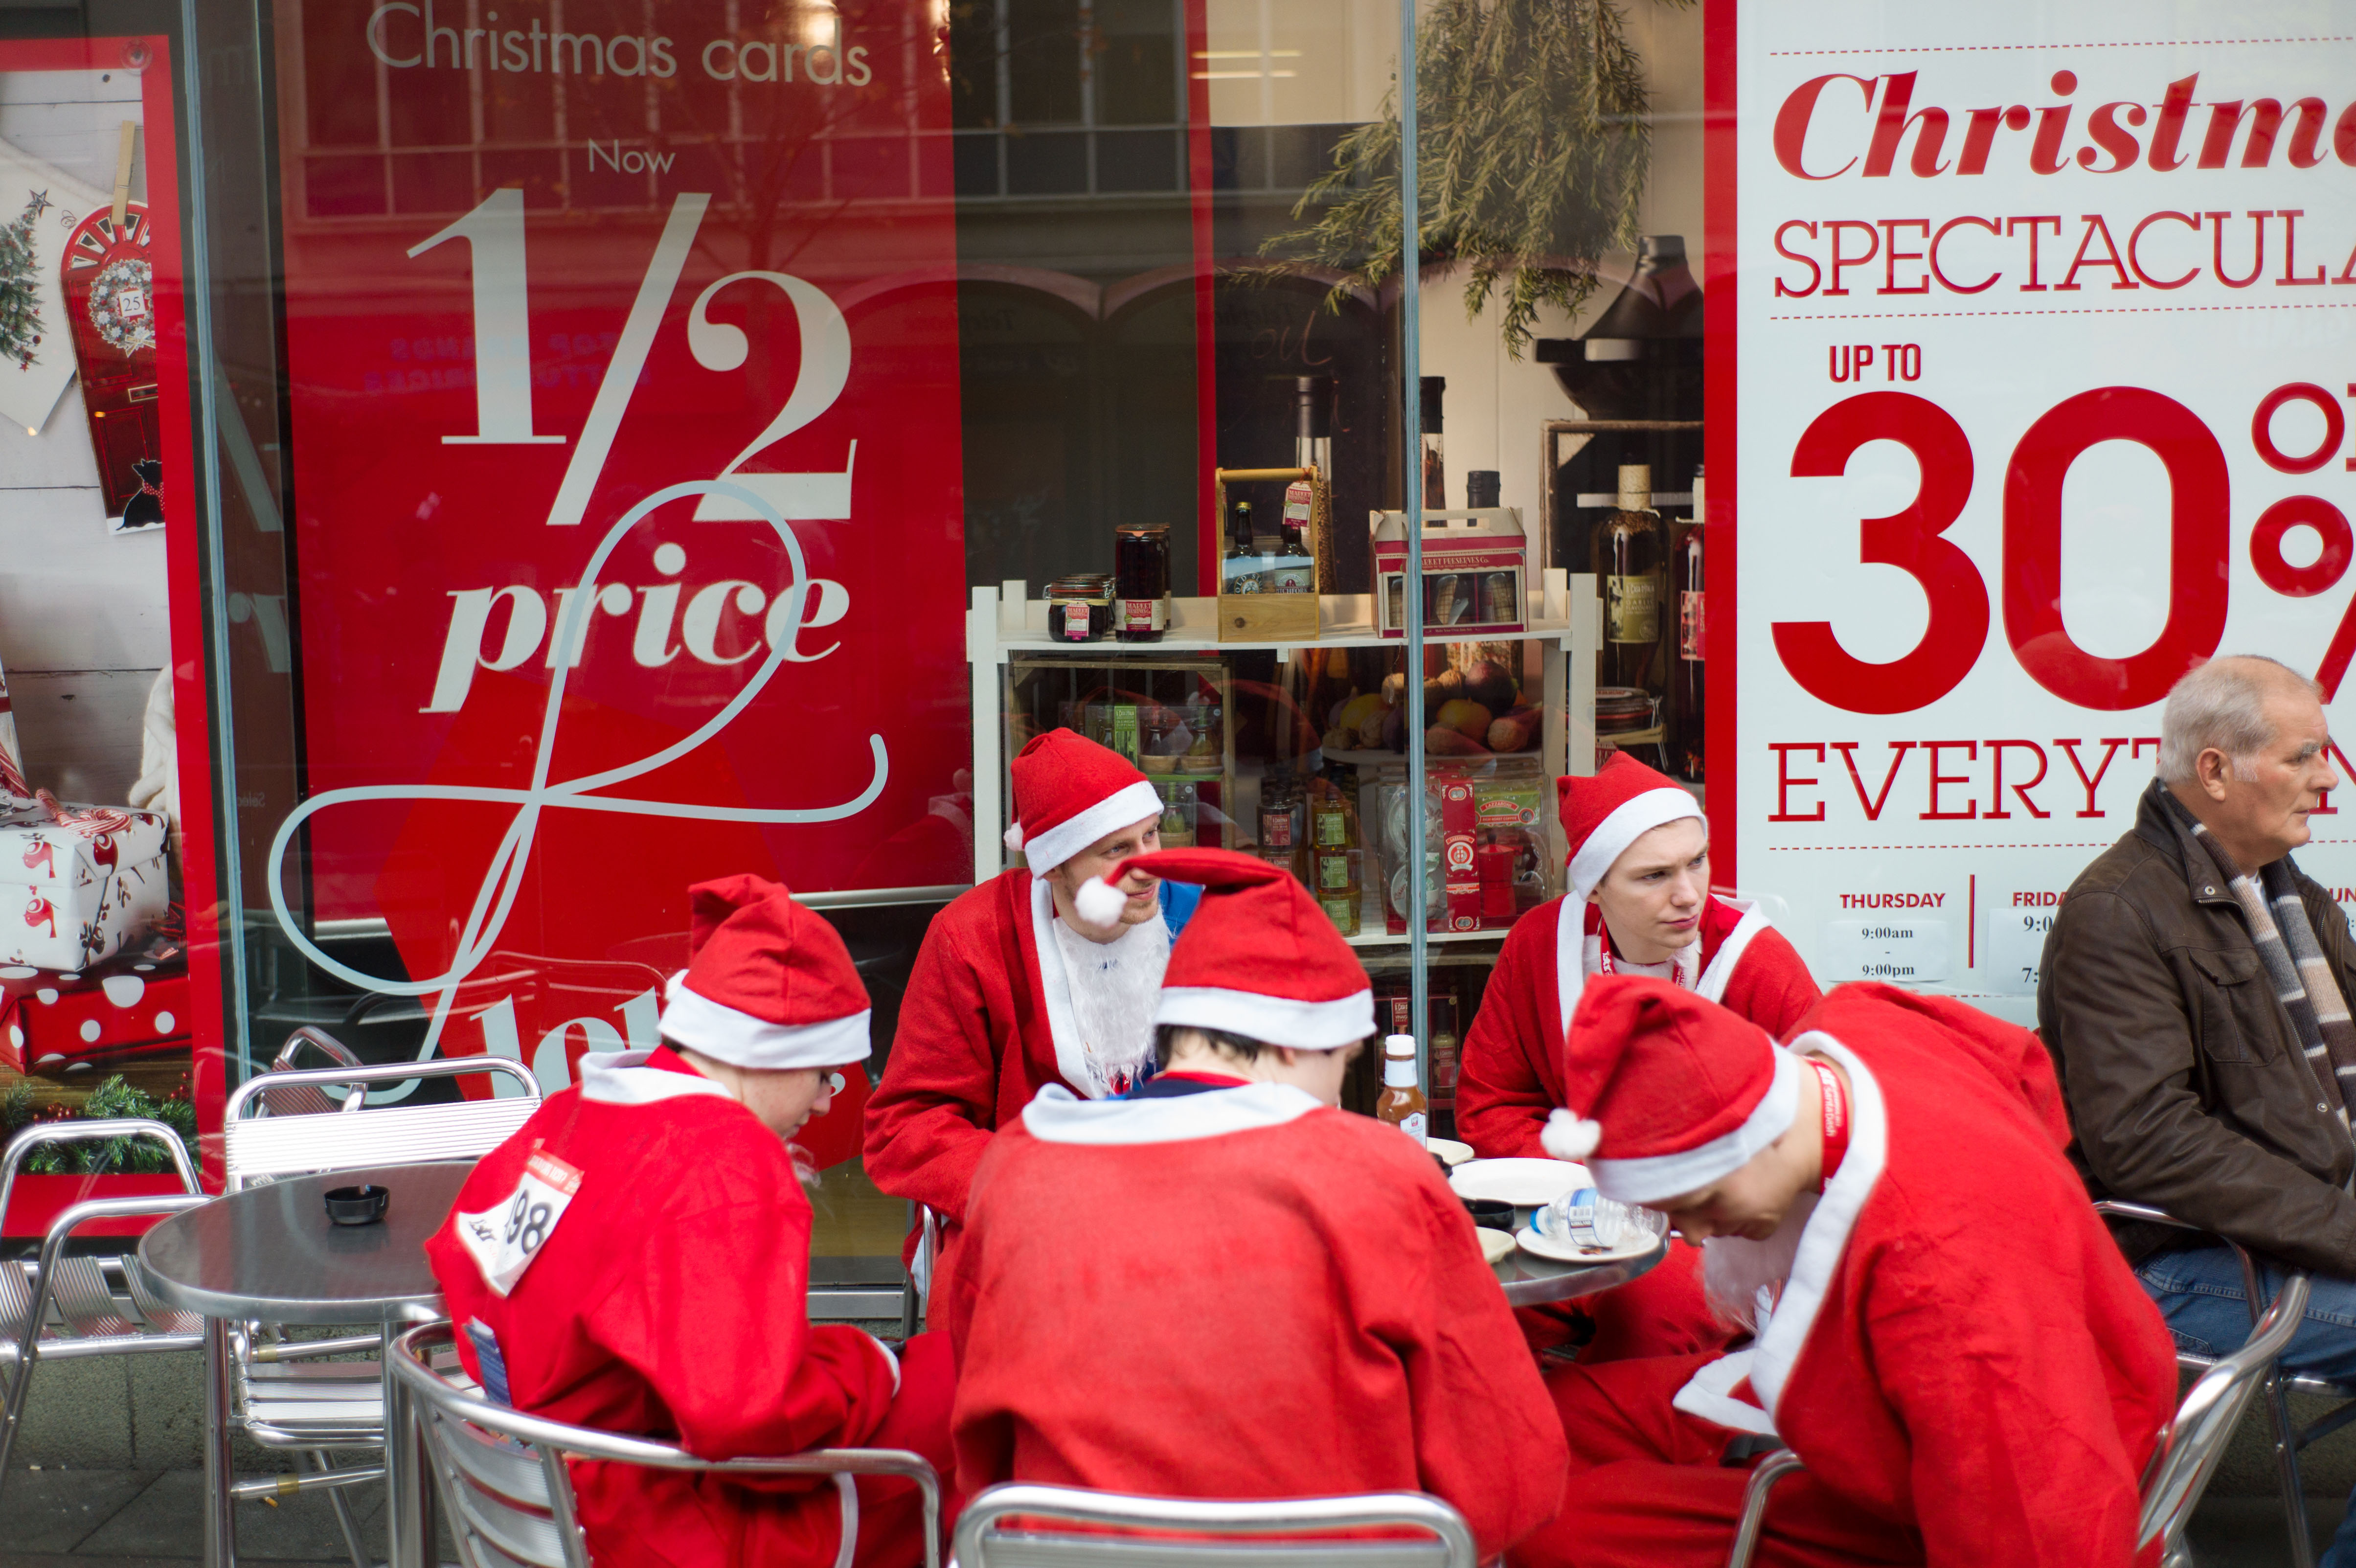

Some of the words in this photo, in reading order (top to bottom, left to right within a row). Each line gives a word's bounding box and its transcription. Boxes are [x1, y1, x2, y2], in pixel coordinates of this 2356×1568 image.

[366, 0, 676, 77] Christmas
[702, 18, 872, 87] cards
[589, 138, 675, 175] Now
[123, 296, 140, 312] 25
[407, 187, 857, 526] 1/2
[1829, 345, 1873, 382] UP
[1882, 344, 1922, 381] TO
[1235, 575, 1247, 593] OLD
[418, 543, 850, 713] price
[1840, 892, 1946, 909] THURSDAY
[2012, 891, 2067, 907] FRIDA
[1862, 927, 1913, 939] 9:00am
[2023, 915, 2053, 932] 9:0
[1862, 963, 1915, 978] 9:00pm
[1824, 1086, 1834, 1113] Santa
[1826, 1113, 1836, 1137] Dash
[507, 1188, 553, 1255] 98
